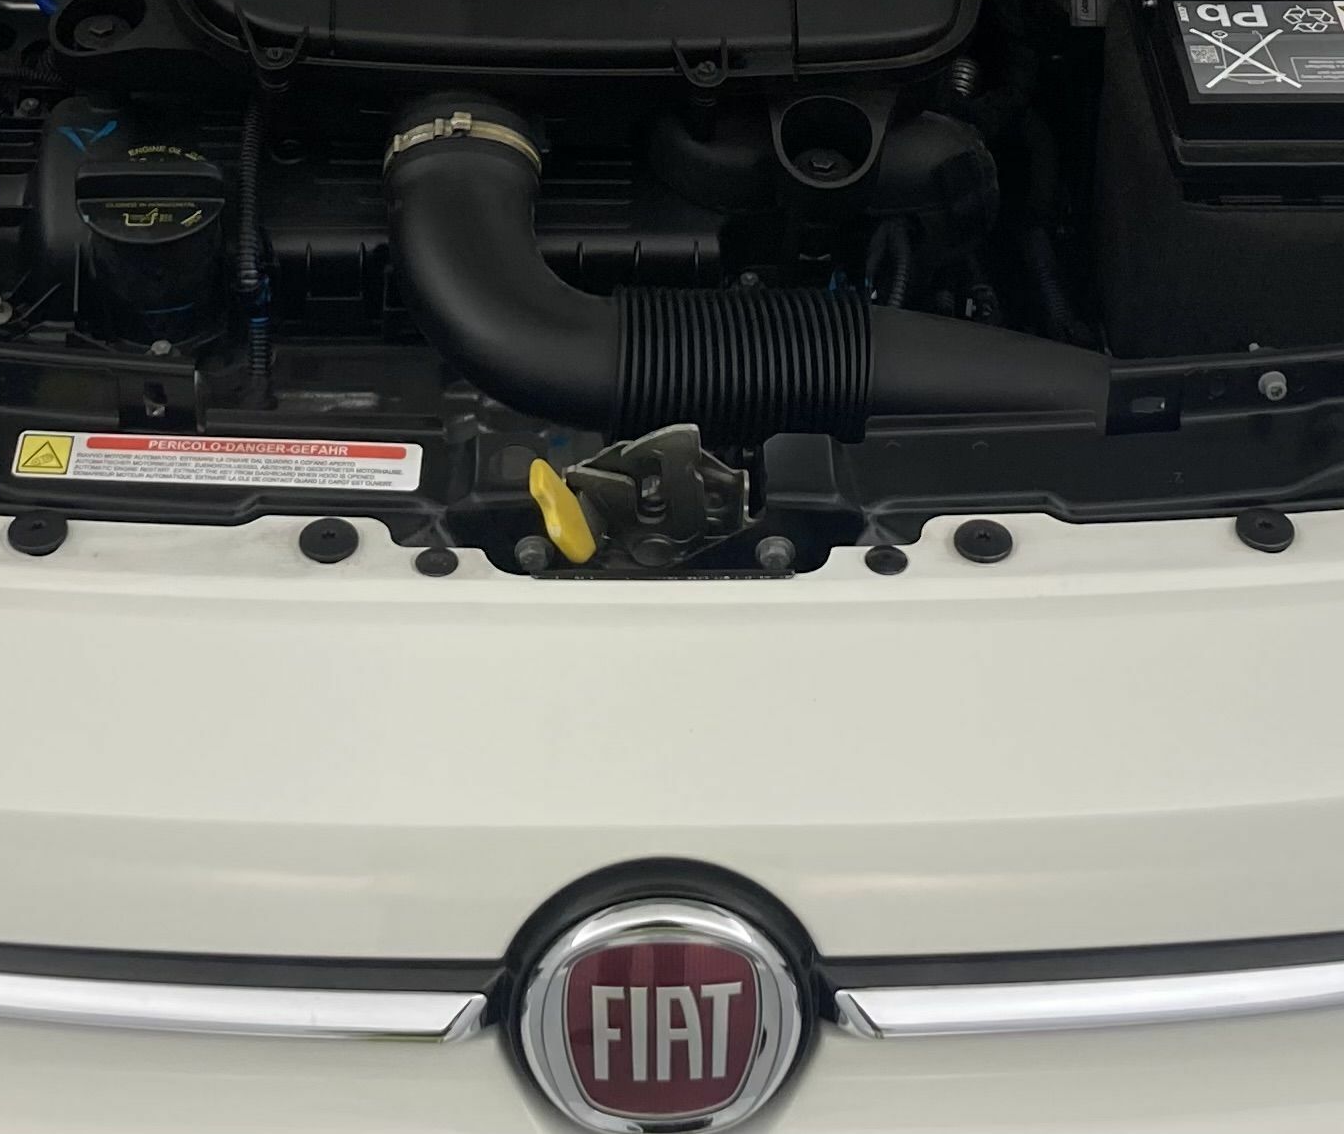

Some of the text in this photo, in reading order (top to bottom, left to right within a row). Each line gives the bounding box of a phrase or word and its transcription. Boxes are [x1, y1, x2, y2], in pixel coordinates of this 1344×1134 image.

[1196, 3, 1269, 27] Pb
[148, 440, 348, 456] PERICOLO-DANGER-GEFAHR
[591, 982, 742, 1081] FIAT
